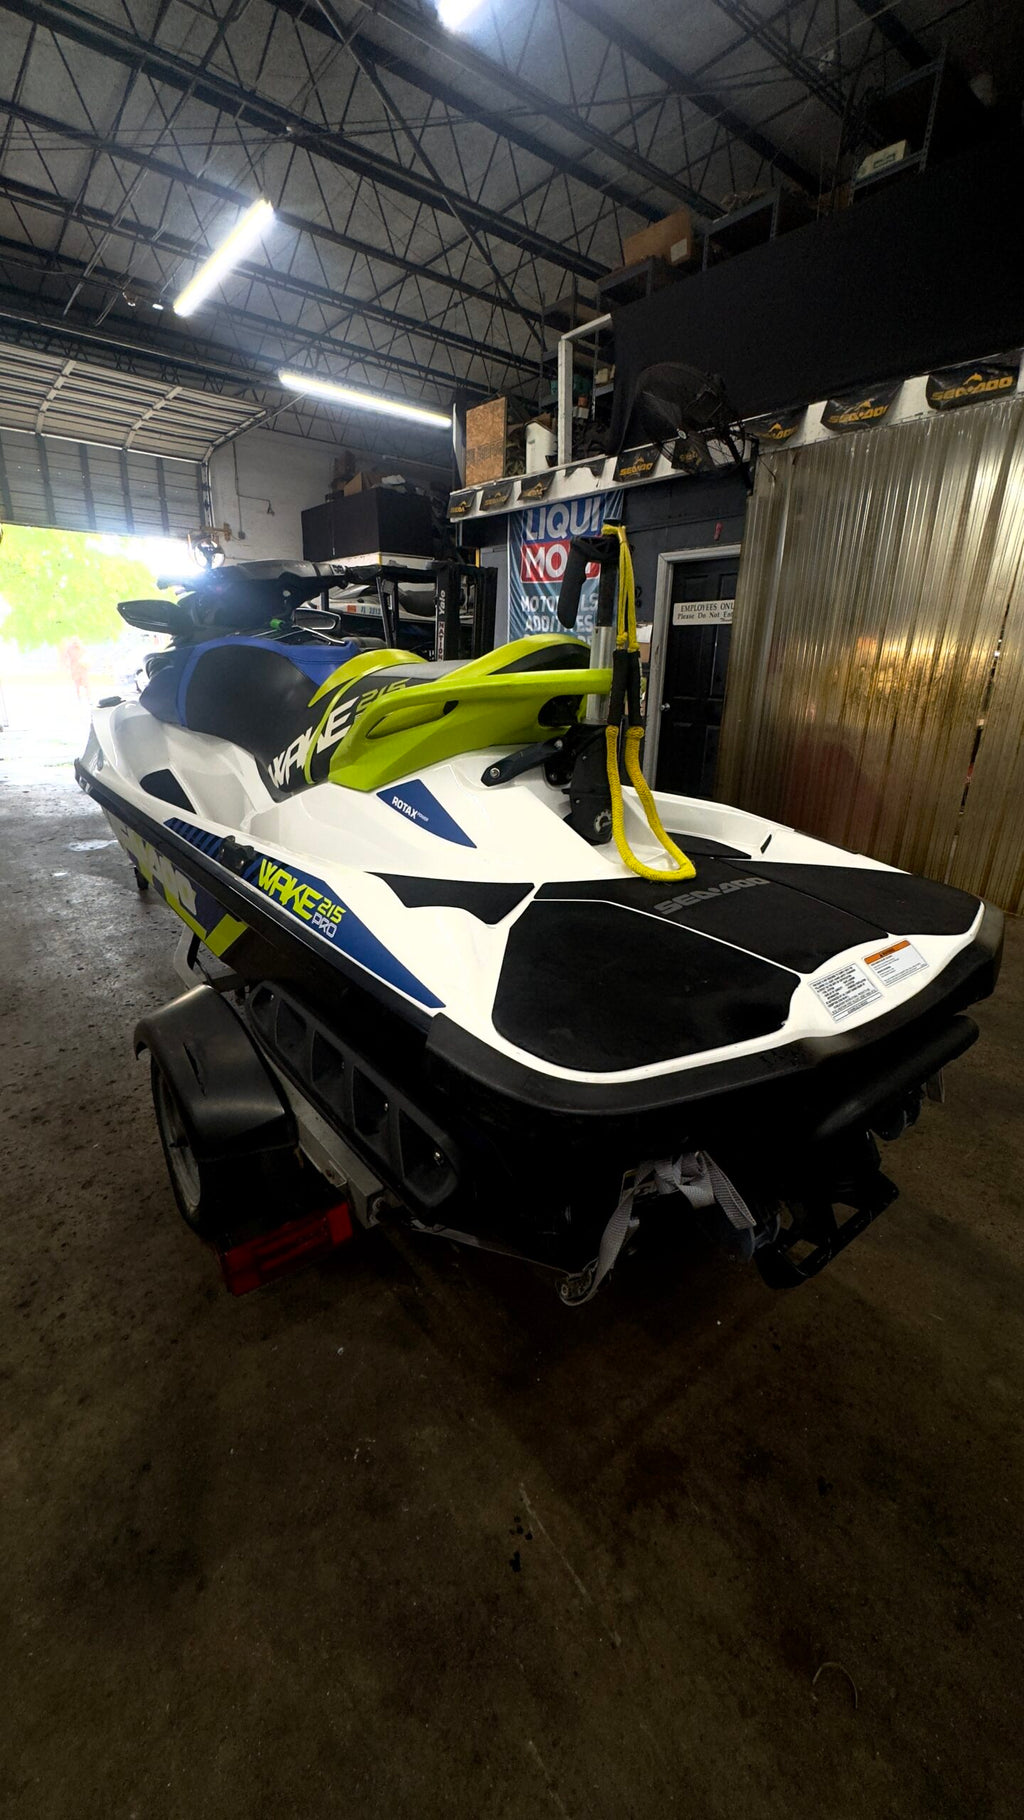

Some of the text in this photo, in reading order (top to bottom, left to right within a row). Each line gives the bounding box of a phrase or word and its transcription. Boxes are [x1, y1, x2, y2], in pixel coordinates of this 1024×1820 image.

[526, 497, 600, 541] LIQUI
[680, 602, 735, 612] EMPLOYEES ONL
[709, 611, 721, 619] Not
[268, 696, 360, 789] WAKE
[391, 795, 418, 820] ROTAX
[258, 858, 347, 924] WAKE 215
[311, 911, 338, 938] PRO
